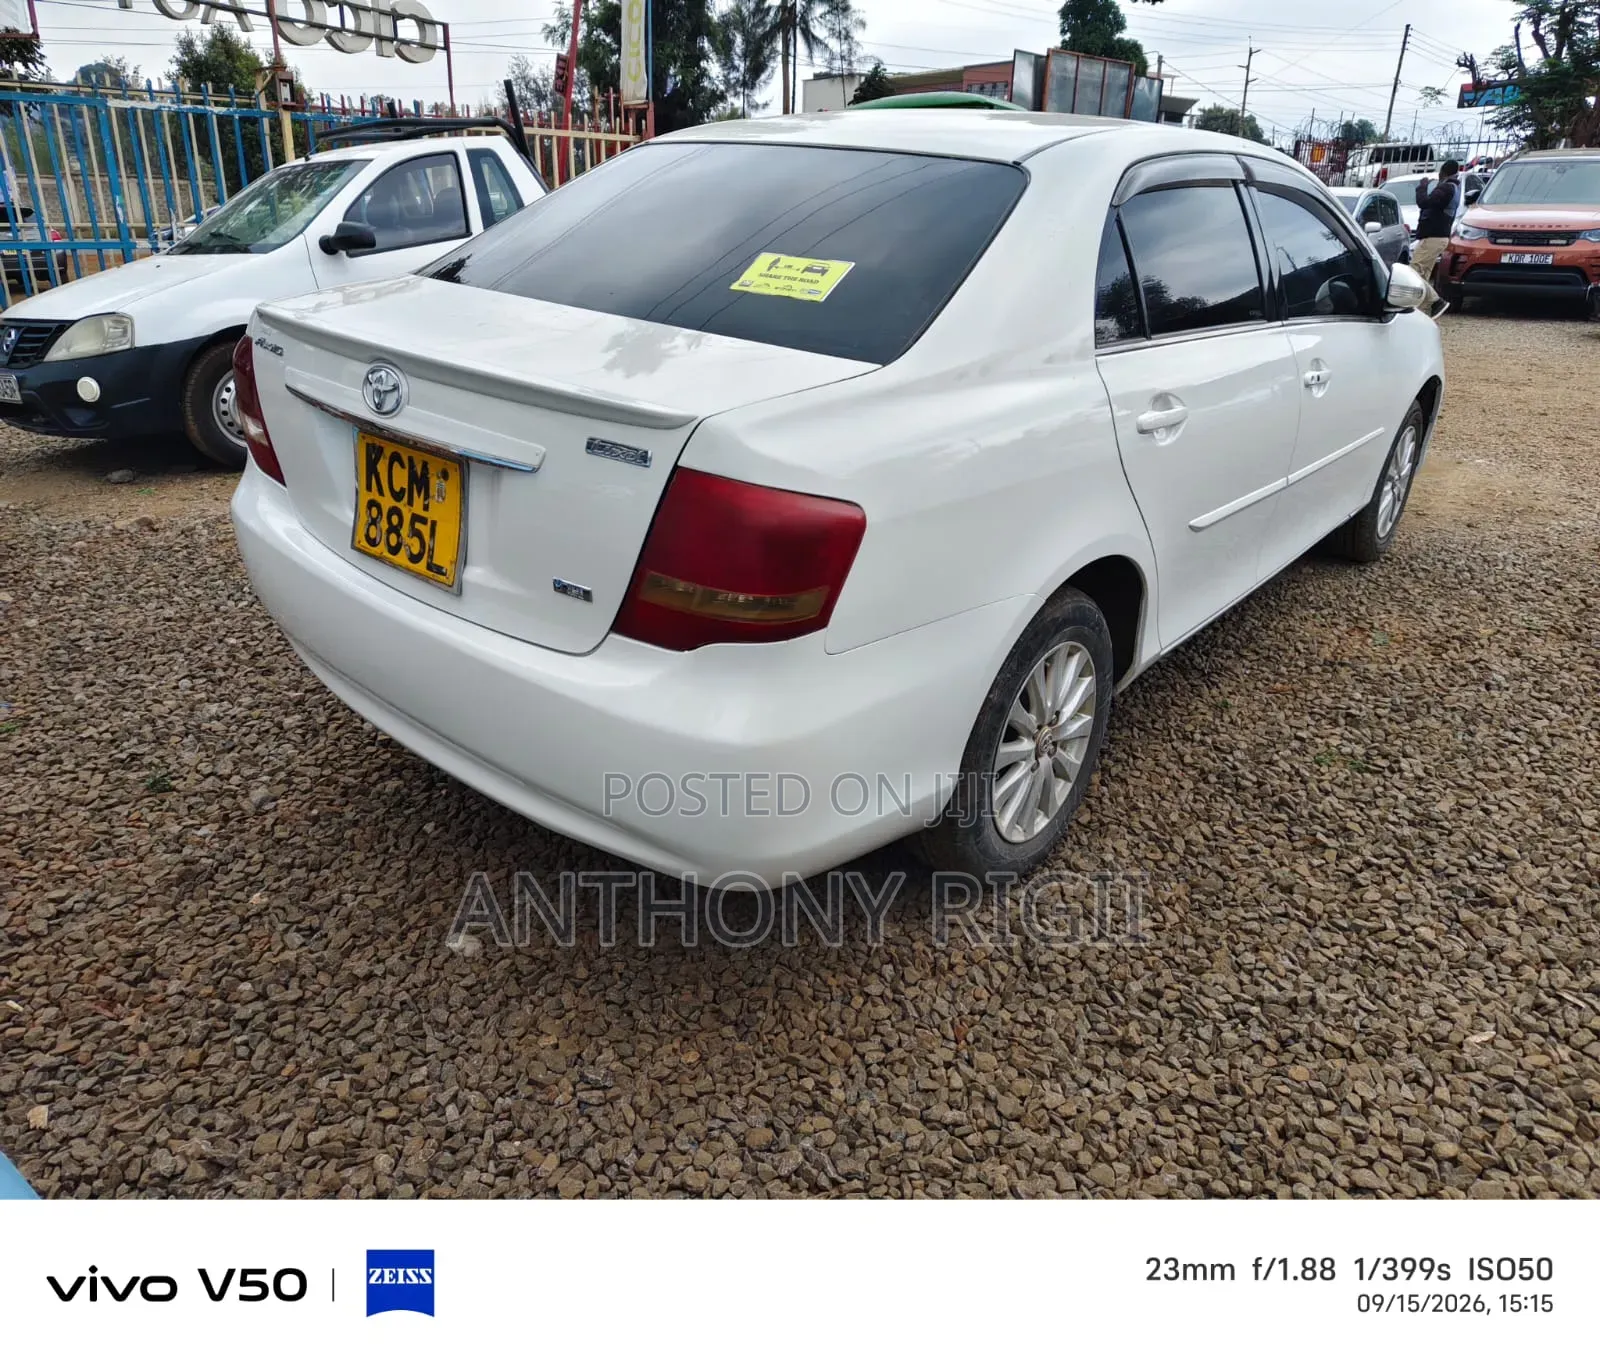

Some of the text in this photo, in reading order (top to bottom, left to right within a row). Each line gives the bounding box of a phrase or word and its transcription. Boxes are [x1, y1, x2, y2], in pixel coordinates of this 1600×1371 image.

[1507, 253, 1551, 264] KDR 100E
[365, 442, 430, 512] KCM
[364, 498, 448, 577] 885L
